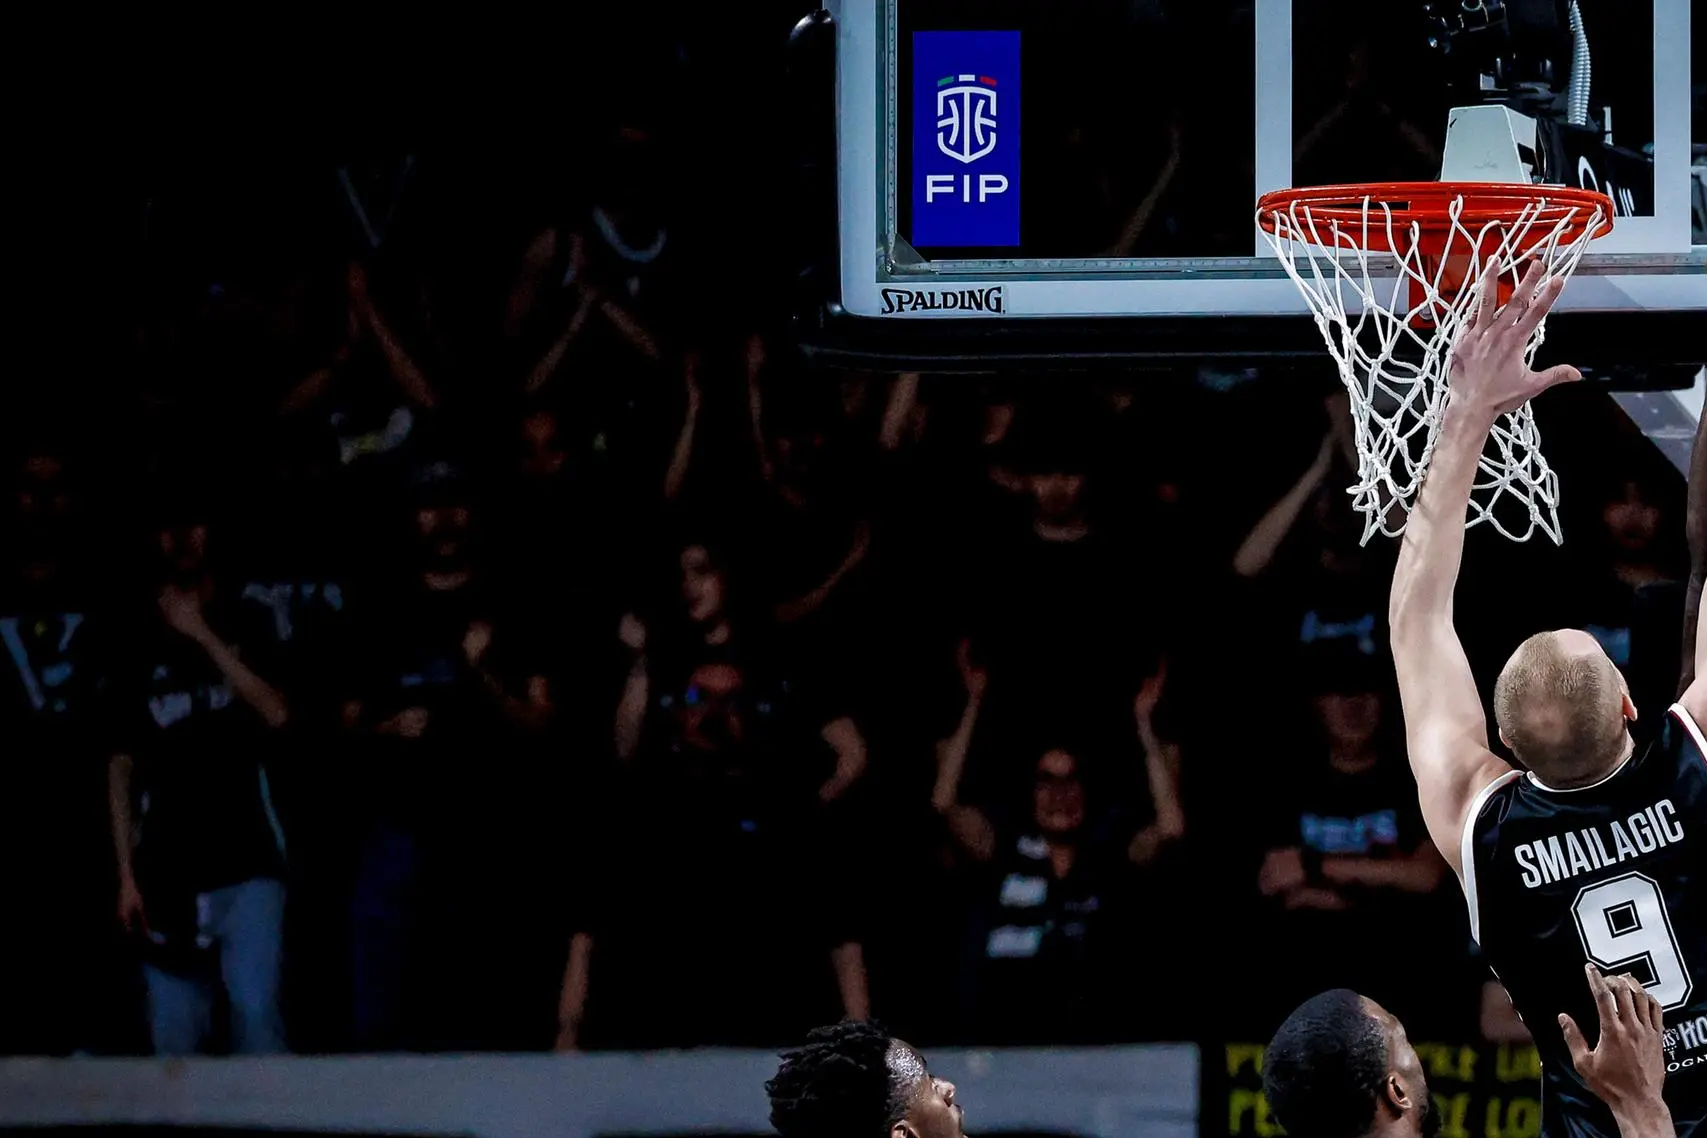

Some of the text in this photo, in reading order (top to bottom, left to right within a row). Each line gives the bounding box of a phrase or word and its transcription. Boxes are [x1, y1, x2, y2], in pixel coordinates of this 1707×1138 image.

[926, 174, 1009, 203] FIP
[881, 286, 1003, 314] SPALDING
[1514, 798, 1684, 889] SMAILAGIC
[1570, 871, 1693, 1012] 9
